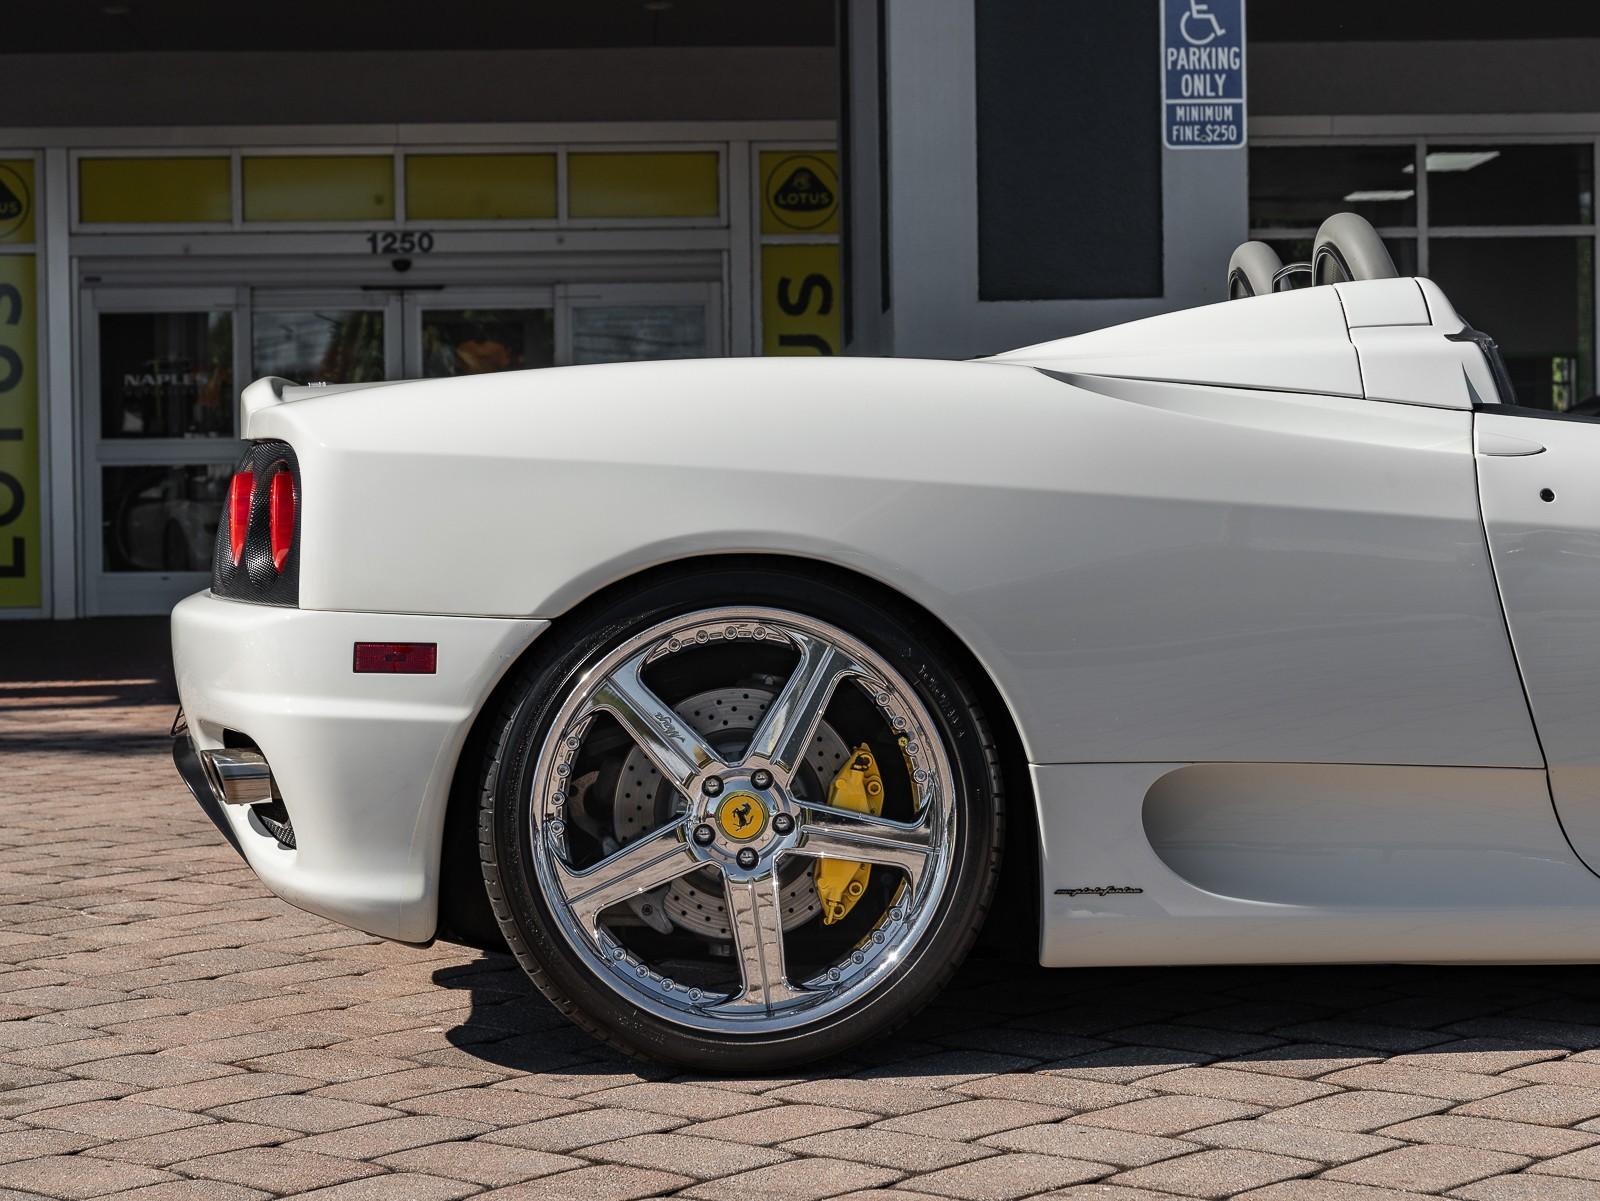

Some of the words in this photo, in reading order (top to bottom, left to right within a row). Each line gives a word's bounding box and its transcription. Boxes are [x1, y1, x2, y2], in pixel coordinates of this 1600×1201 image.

[1167, 47, 1240, 70] PARKING
[1181, 74, 1226, 97] ONLY
[1176, 105, 1233, 121] MINIMUM
[1172, 125, 1200, 142] FINE
[1205, 124, 1237, 143] $250
[778, 192, 830, 205] LOTUS
[367, 231, 434, 254] 1250
